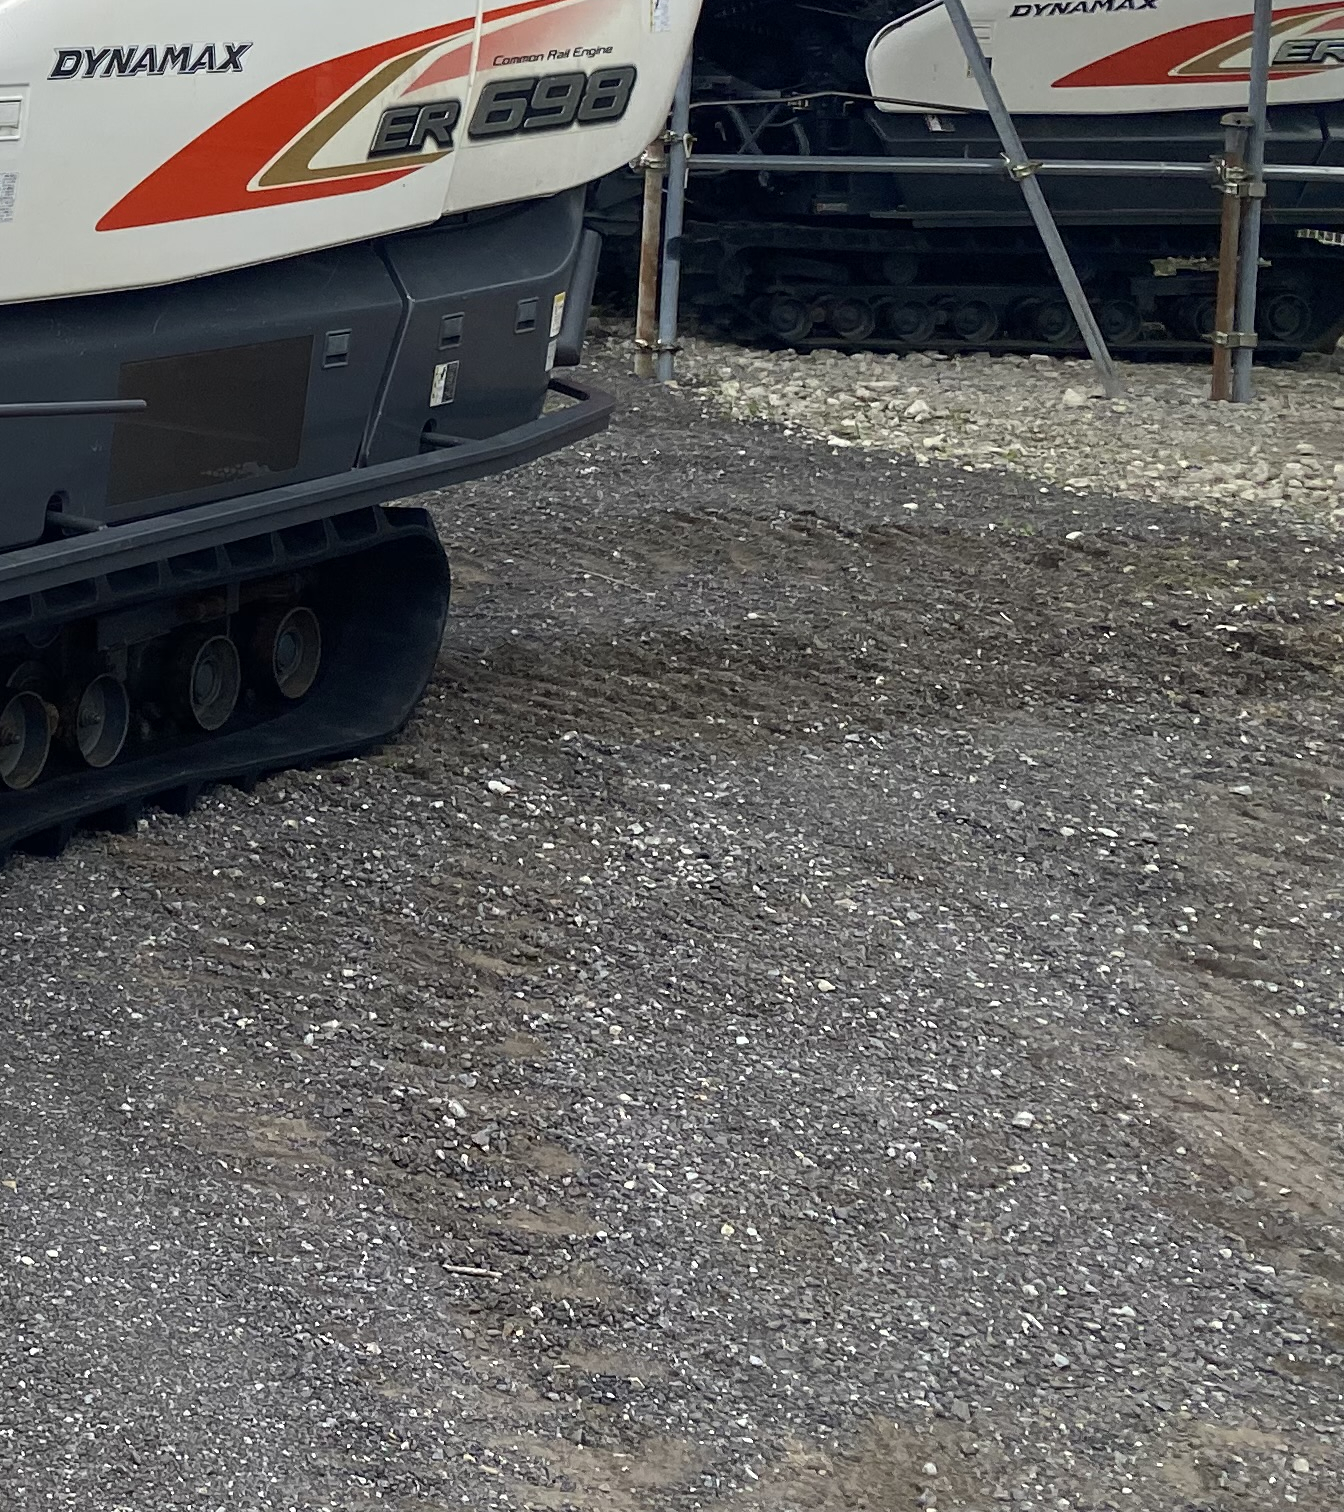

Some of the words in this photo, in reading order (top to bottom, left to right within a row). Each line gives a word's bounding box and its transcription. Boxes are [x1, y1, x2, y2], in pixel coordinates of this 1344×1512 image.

[47, 42, 254, 80] DYNAMAX
[493, 52, 545, 67] Common
[547, 48, 571, 61] Rail
[573, 45, 613, 58] Engine
[367, 99, 461, 159] ER
[468, 65, 637, 140] 698
